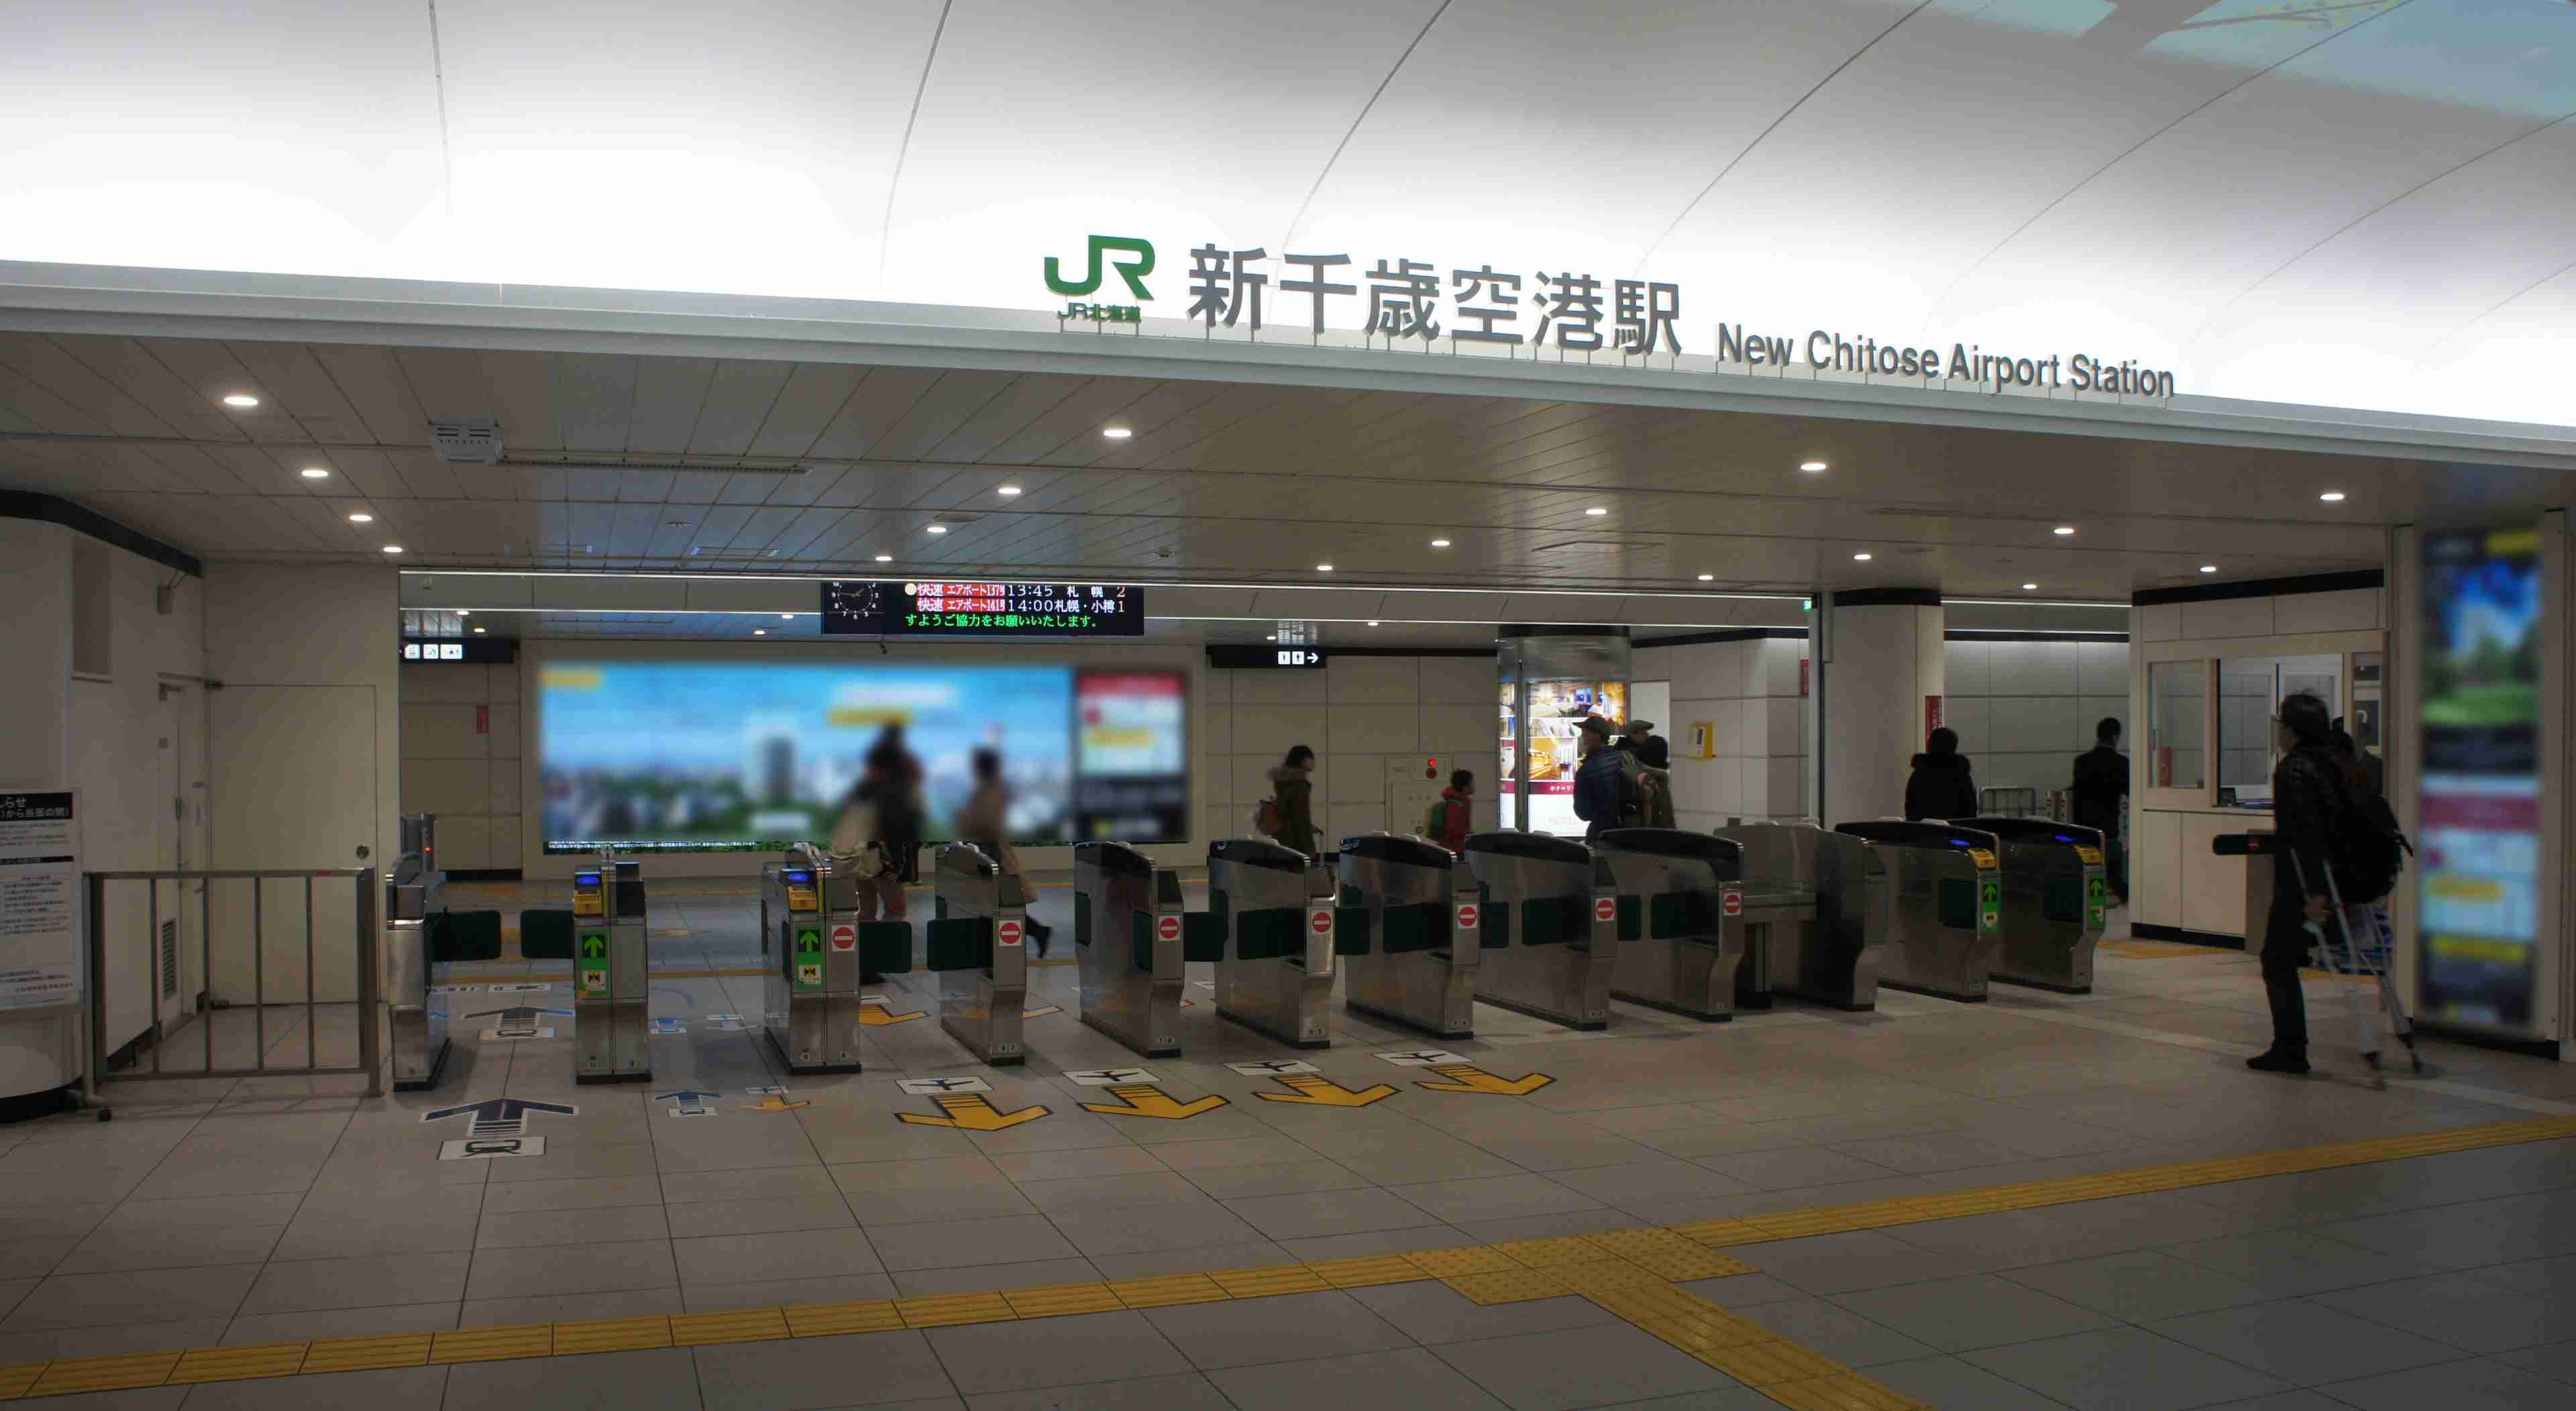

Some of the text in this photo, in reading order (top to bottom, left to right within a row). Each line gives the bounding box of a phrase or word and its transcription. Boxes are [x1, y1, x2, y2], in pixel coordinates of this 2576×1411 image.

[1044, 235, 1155, 300] JR
[1186, 243, 1682, 357] 新千歳空港駅
[1717, 323, 2175, 397] New Chitose Airport Station
[1008, 585, 1053, 597] 13:45
[1116, 586, 1126, 598] 2
[1008, 600, 1053, 612] 14:00
[1118, 600, 1125, 612] 1
[906, 614, 1096, 629] すようご協力をお願いいたします。
